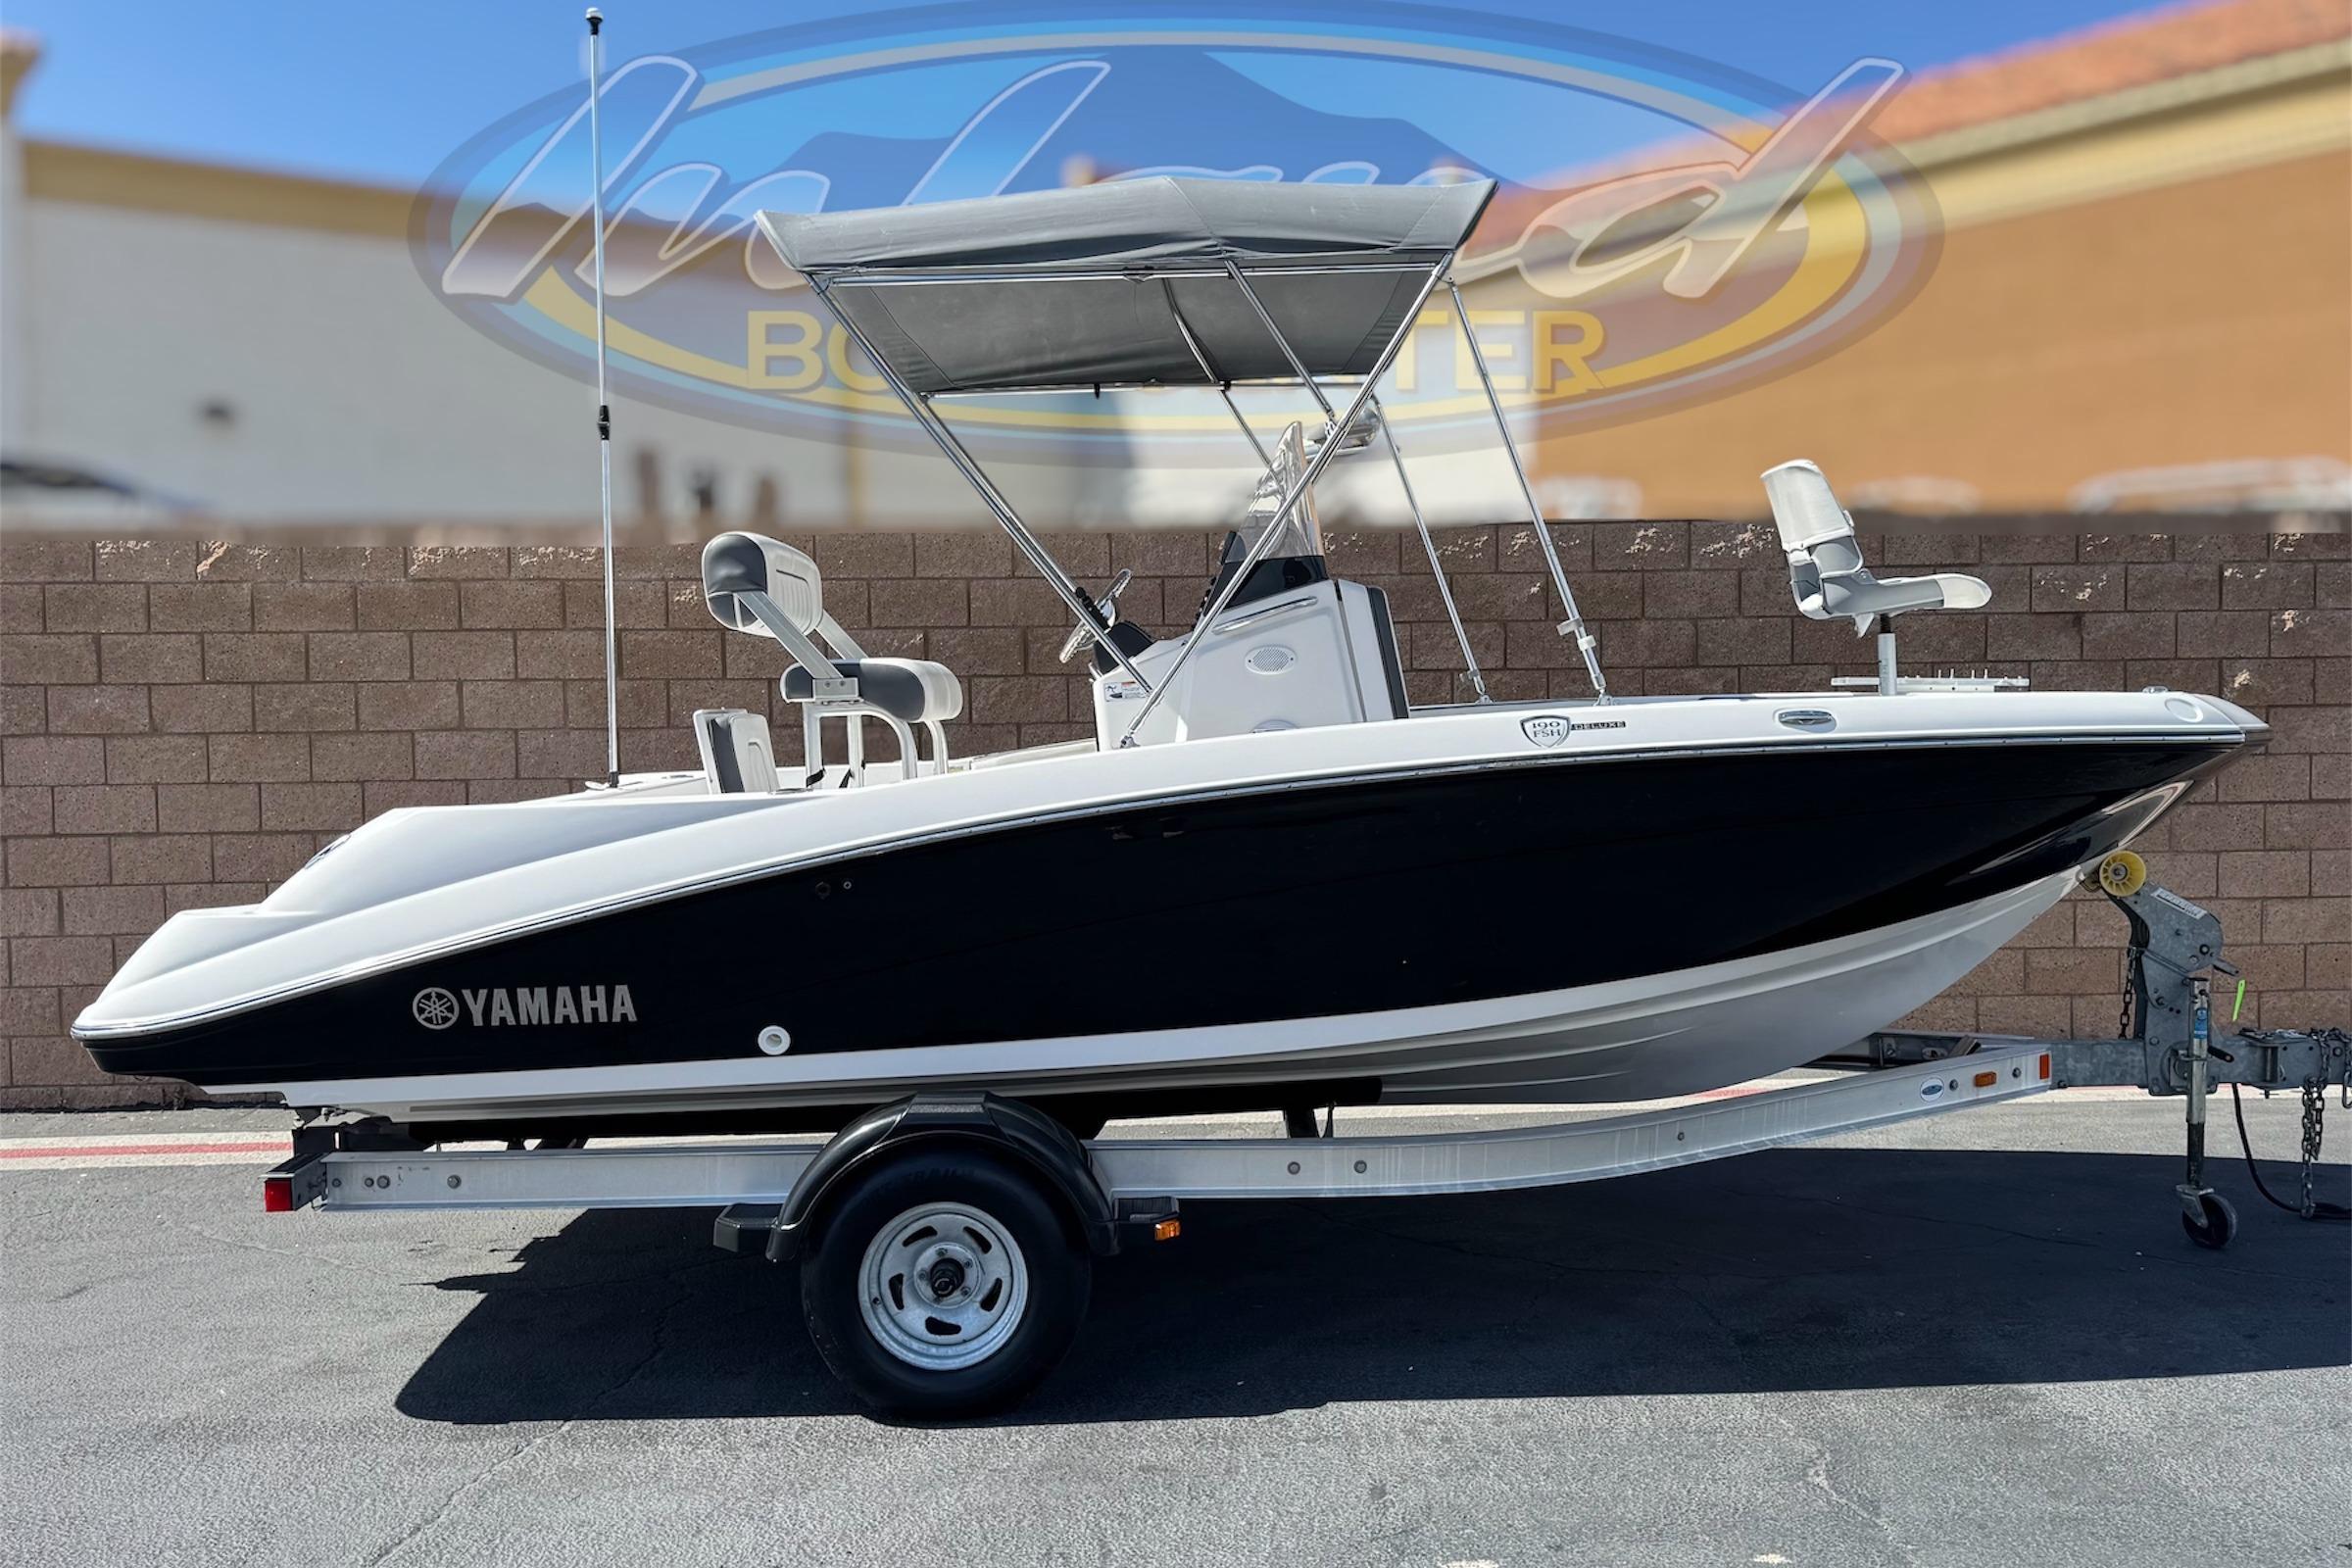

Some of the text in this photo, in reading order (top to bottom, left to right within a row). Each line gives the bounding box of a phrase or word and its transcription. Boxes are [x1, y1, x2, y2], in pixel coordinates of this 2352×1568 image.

[1532, 720, 1561, 730] 190
[1571, 720, 1626, 731] DELUXE
[1533, 729, 1561, 738] FSH
[462, 985, 638, 1027] YAMAHA
